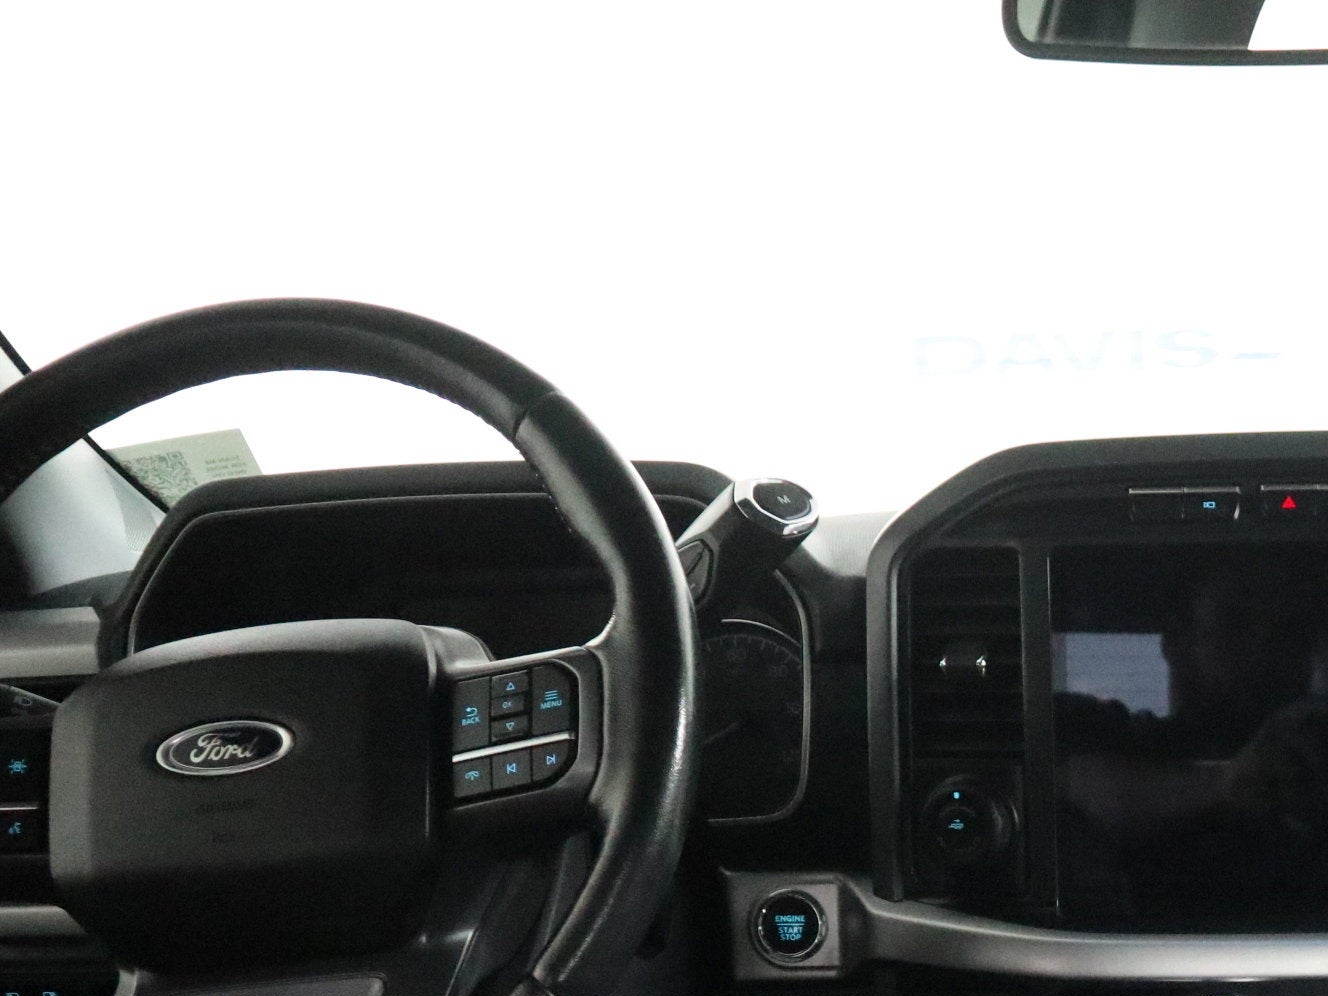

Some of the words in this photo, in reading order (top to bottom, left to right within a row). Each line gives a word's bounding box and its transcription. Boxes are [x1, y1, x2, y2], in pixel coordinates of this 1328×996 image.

[777, 494, 791, 505] M
[540, 700, 563, 709] MENU
[461, 717, 480, 726] BACK
[190, 733, 257, 763] Ford
[778, 926, 804, 934] START
[780, 933, 802, 941] STOP
